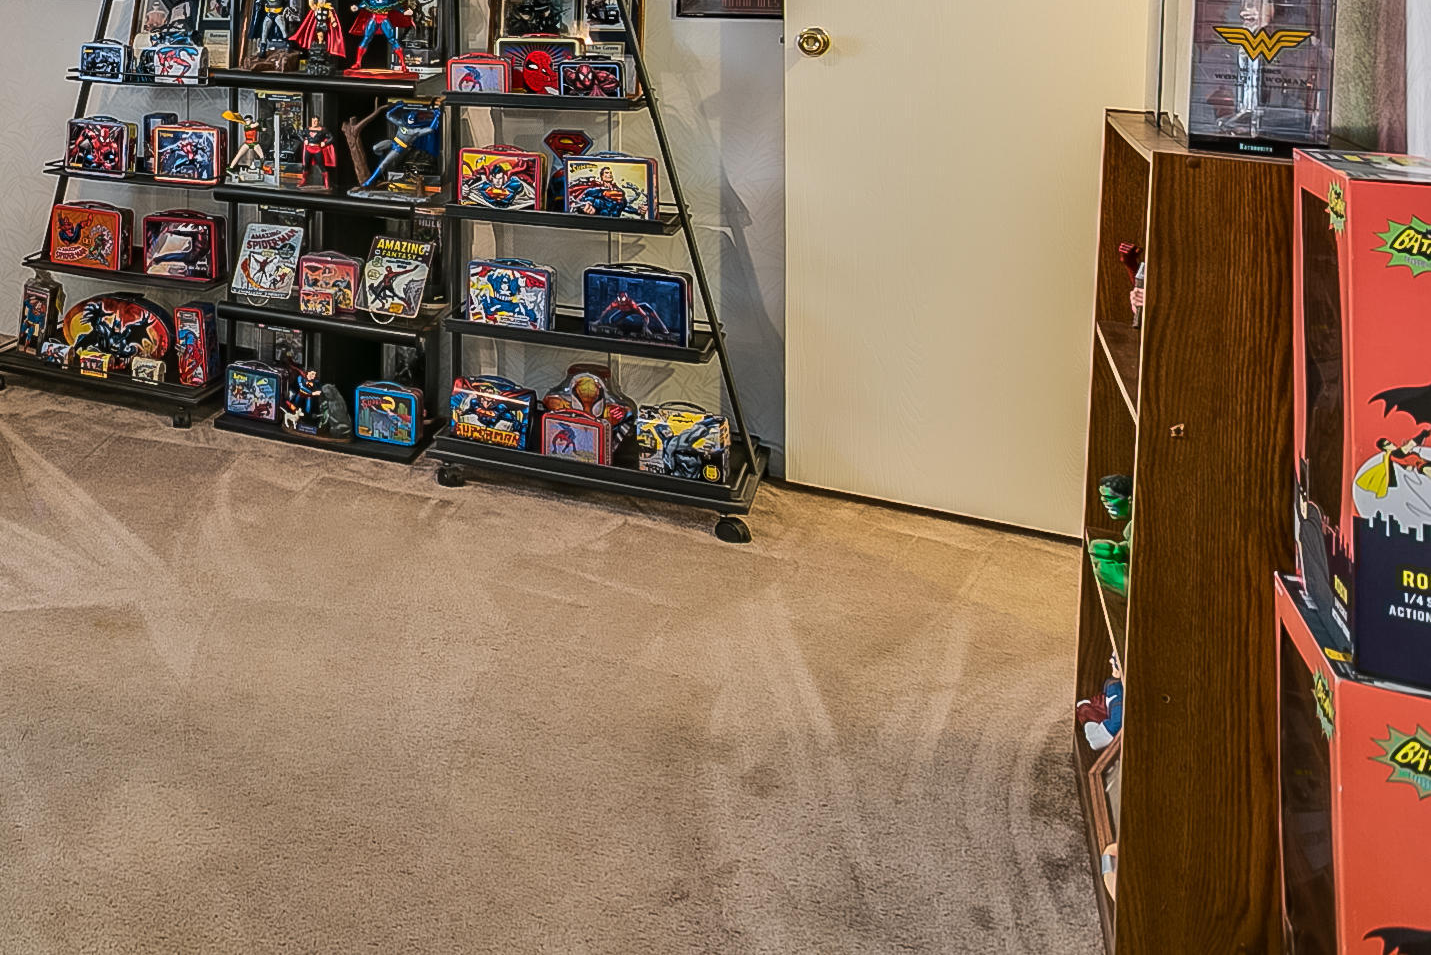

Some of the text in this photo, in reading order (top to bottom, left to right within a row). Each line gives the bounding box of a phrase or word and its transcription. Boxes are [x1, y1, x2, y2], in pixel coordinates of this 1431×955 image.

[246, 228, 299, 250] SPIDER-MAN
[250, 230, 281, 239] AMAZING
[376, 238, 425, 256] AMAZING
[382, 249, 417, 260] FANTASY
[455, 422, 520, 449] SUPERMAN
[1402, 570, 1431, 590] RO
[1404, 592, 1424, 606] 1/4
[1394, 741, 1431, 772] BA
